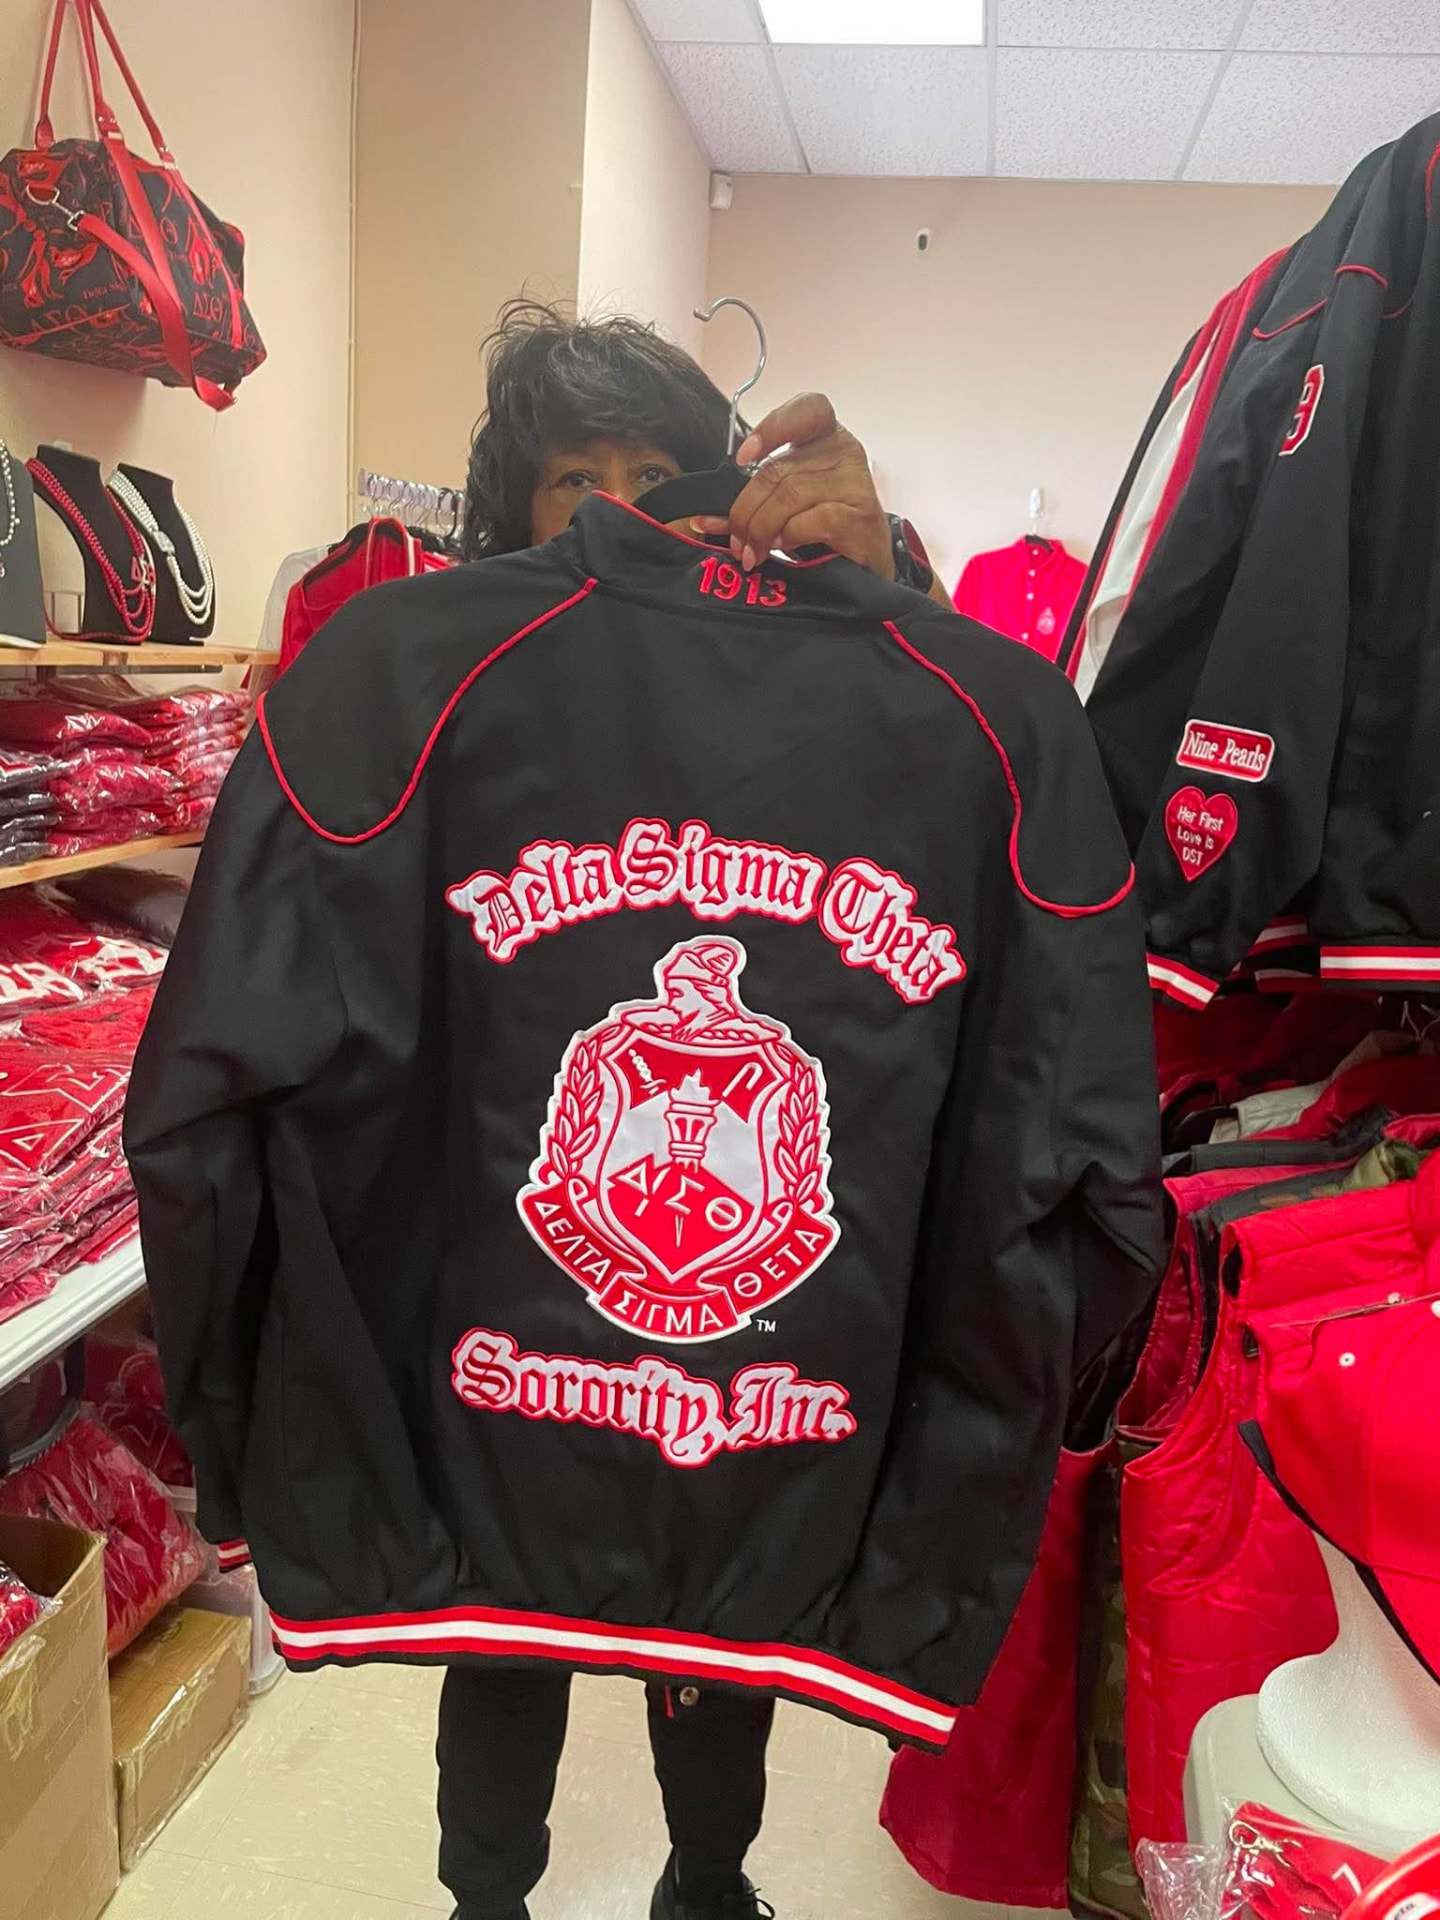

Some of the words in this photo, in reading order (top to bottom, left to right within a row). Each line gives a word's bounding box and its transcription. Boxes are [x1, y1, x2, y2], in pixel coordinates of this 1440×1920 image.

[699, 556, 787, 607] 1913
[1184, 730, 1219, 761] Nine
[1220, 738, 1266, 772] Pearls
[1177, 805, 1197, 823] Her
[1199, 809, 1225, 832] First
[1176, 826, 1202, 846] Love
[1182, 847, 1204, 866] DST
[464, 845, 616, 957] Delta
[619, 821, 813, 908] Sigma
[826, 863, 953, 991] Theta
[757, 1319, 776, 1333] TM
[731, 1372, 850, 1447] Inc.
